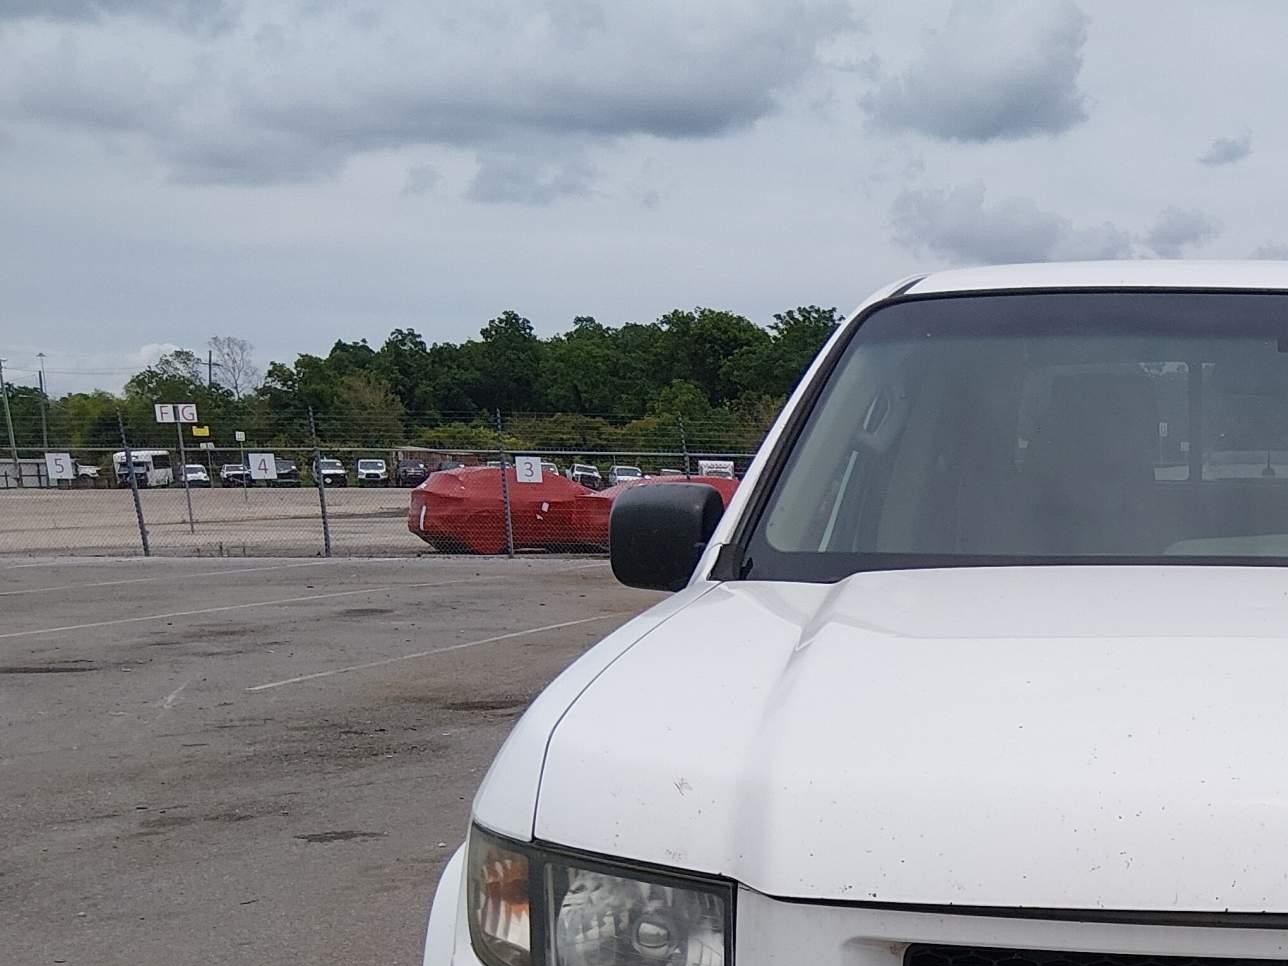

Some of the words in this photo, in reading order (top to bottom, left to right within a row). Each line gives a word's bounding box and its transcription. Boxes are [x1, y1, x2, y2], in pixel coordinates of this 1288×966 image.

[160, 405, 169, 421] F
[181, 405, 195, 421] G
[54, 458, 65, 474] 5
[258, 458, 269, 474] 4
[524, 461, 534, 477] 3
